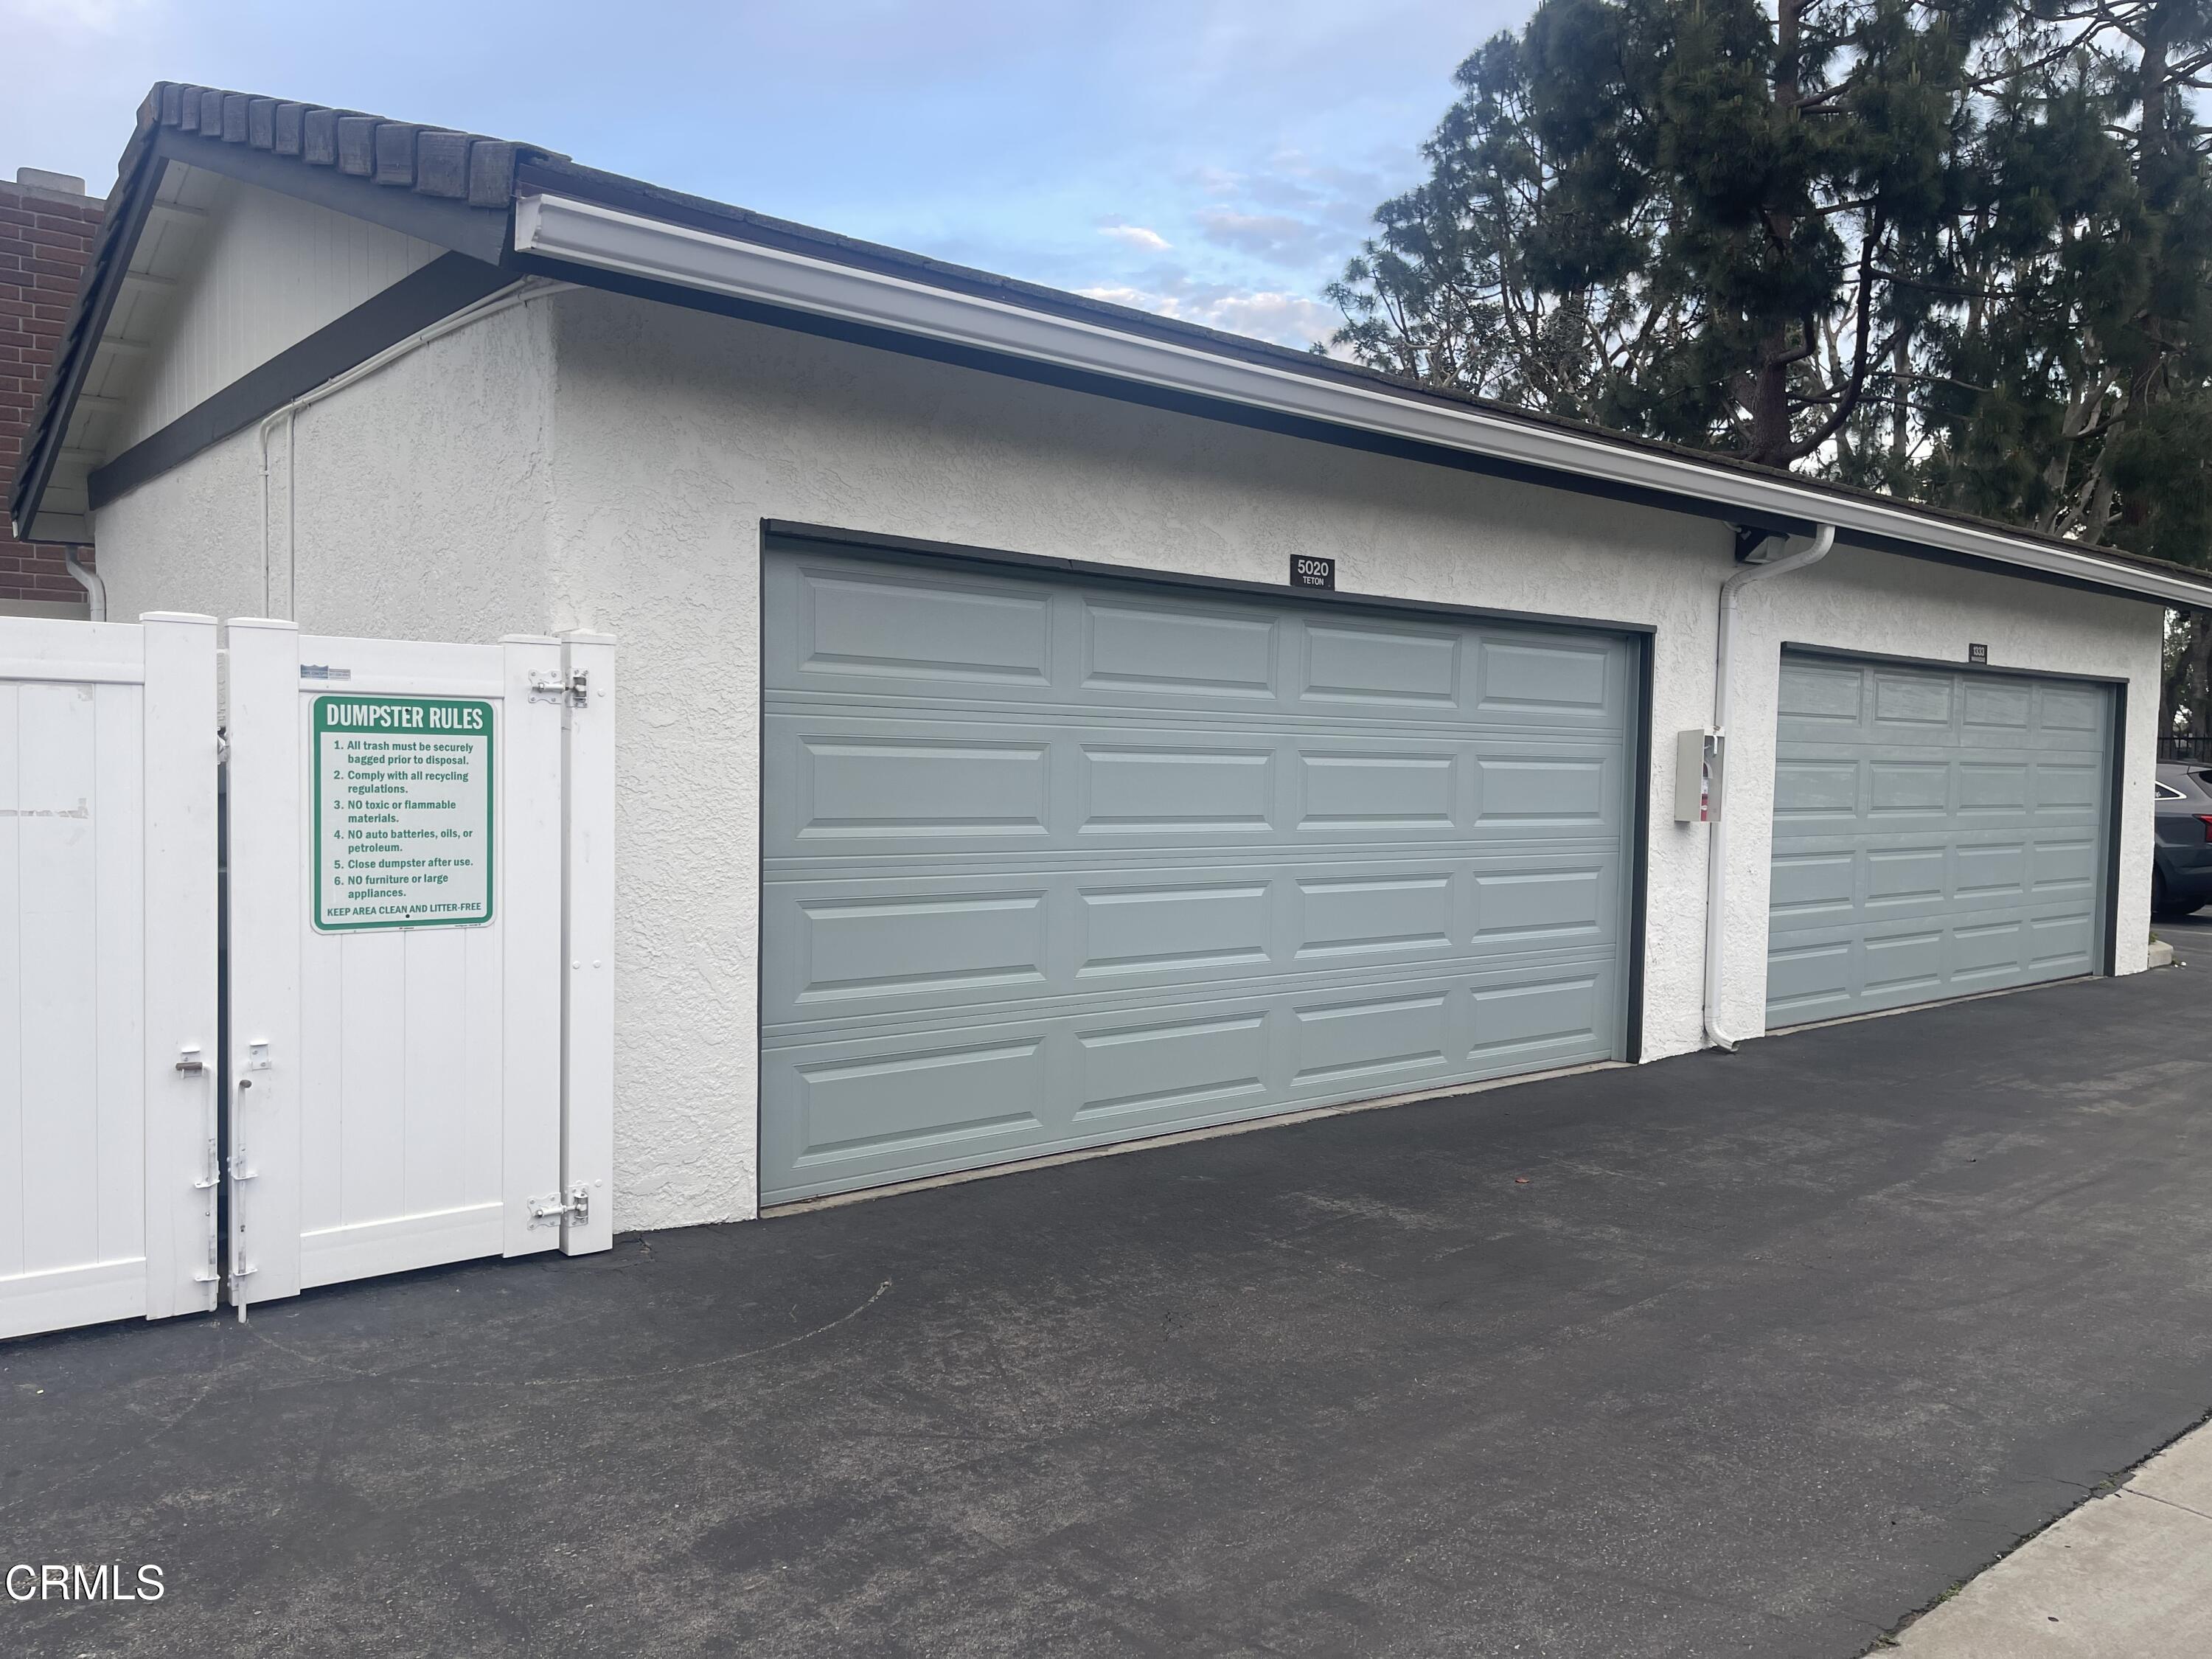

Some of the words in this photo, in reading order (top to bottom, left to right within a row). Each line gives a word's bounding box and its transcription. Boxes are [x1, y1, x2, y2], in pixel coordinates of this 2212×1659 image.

[1298, 560, 1329, 576] 5020
[1303, 577, 1324, 585] TETON
[327, 704, 423, 727] DUMPSTER
[430, 708, 483, 729] RULES
[335, 740, 344, 749] 1.
[347, 741, 360, 750] All
[364, 741, 389, 750] trash
[392, 742, 417, 751] must
[420, 742, 431, 751] be
[434, 743, 473, 754] securely
[348, 754, 385, 765] bagged
[388, 755, 411, 765] prior
[414, 756, 423, 764] to
[426, 756, 468, 766] disposal.
[334, 771, 344, 779] 2.
[348, 771, 385, 782] Comply
[387, 771, 407, 780] with
[411, 771, 422, 780] all
[425, 771, 468, 782] recycling
[348, 785, 408, 795] regulations.
[334, 800, 344, 809] 3.
[348, 800, 362, 809] NO
[366, 800, 389, 809] toxic
[405, 800, 456, 809] flammable
[348, 814, 399, 823] materials.
[334, 830, 344, 839] 4.
[348, 830, 362, 839] NO
[366, 830, 388, 838] auto
[391, 830, 437, 839] batteries,
[441, 829, 460, 839] oils,
[349, 844, 403, 855] petroleum.
[335, 860, 344, 869] 5.
[348, 860, 375, 869] Close
[379, 859, 425, 869] dumpster
[428, 858, 451, 866] after
[335, 877, 344, 885] 6.
[348, 876, 362, 885] NO
[366, 875, 408, 884] furniture
[424, 874, 448, 884] large
[348, 888, 406, 900] appliances.
[327, 908, 350, 916] KEEP
[352, 907, 377, 915] AREA
[379, 905, 407, 914] CLEAN
[410, 905, 428, 913] AND
[431, 902, 481, 912] LITTER-FREE
